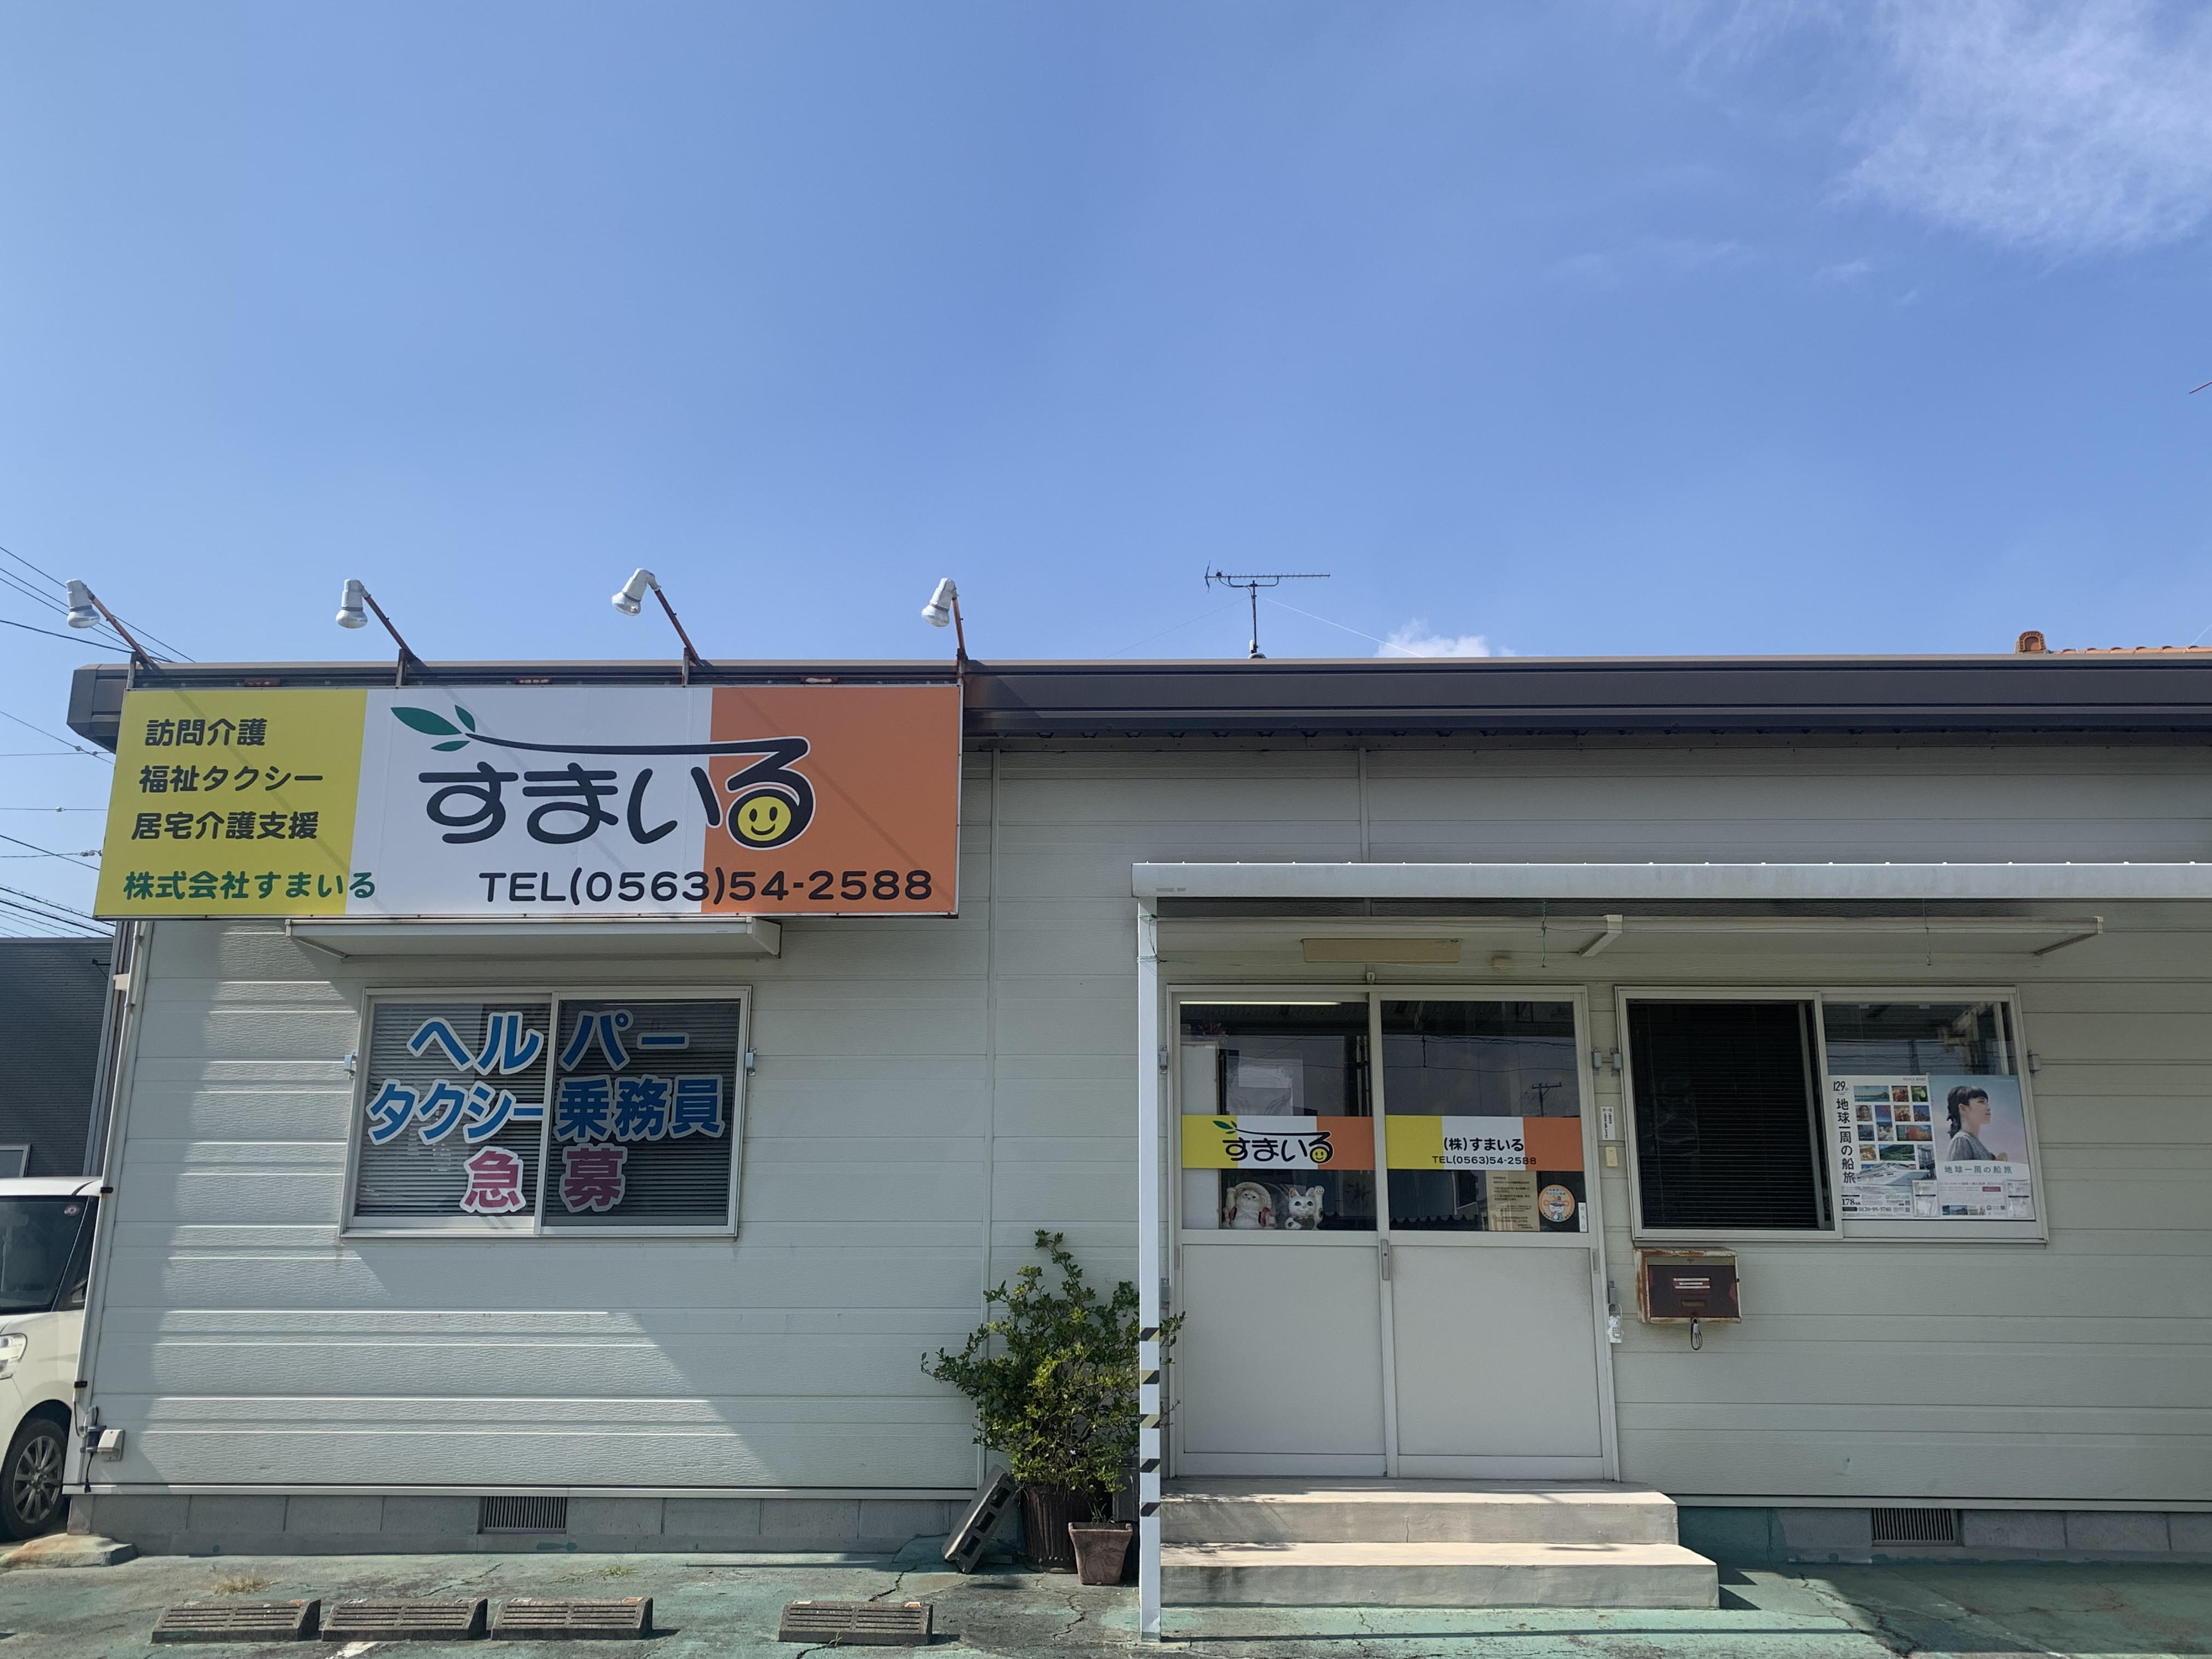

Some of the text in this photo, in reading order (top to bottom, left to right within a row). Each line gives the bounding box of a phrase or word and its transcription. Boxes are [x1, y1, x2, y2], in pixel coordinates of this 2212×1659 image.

[144, 718, 268, 747] 訪問介護
[139, 765, 324, 793] 福祉タクシー
[417, 737, 814, 849] すまいる
[131, 811, 319, 840] 居宅介護支援
[123, 871, 376, 900] 株式会社すまいる
[478, 867, 933, 906] TEL(0563)54-2588
[1222, 1131, 1333, 1163] すまいる
[1443, 1137, 1525, 1152] (株)すまいる
[1836, 1098, 1857, 1184] 地球一周の船旅
[1432, 1155, 1537, 1166] TEL(0563)54-2588
[1944, 1165, 2013, 1173] 地球一周の船旅
